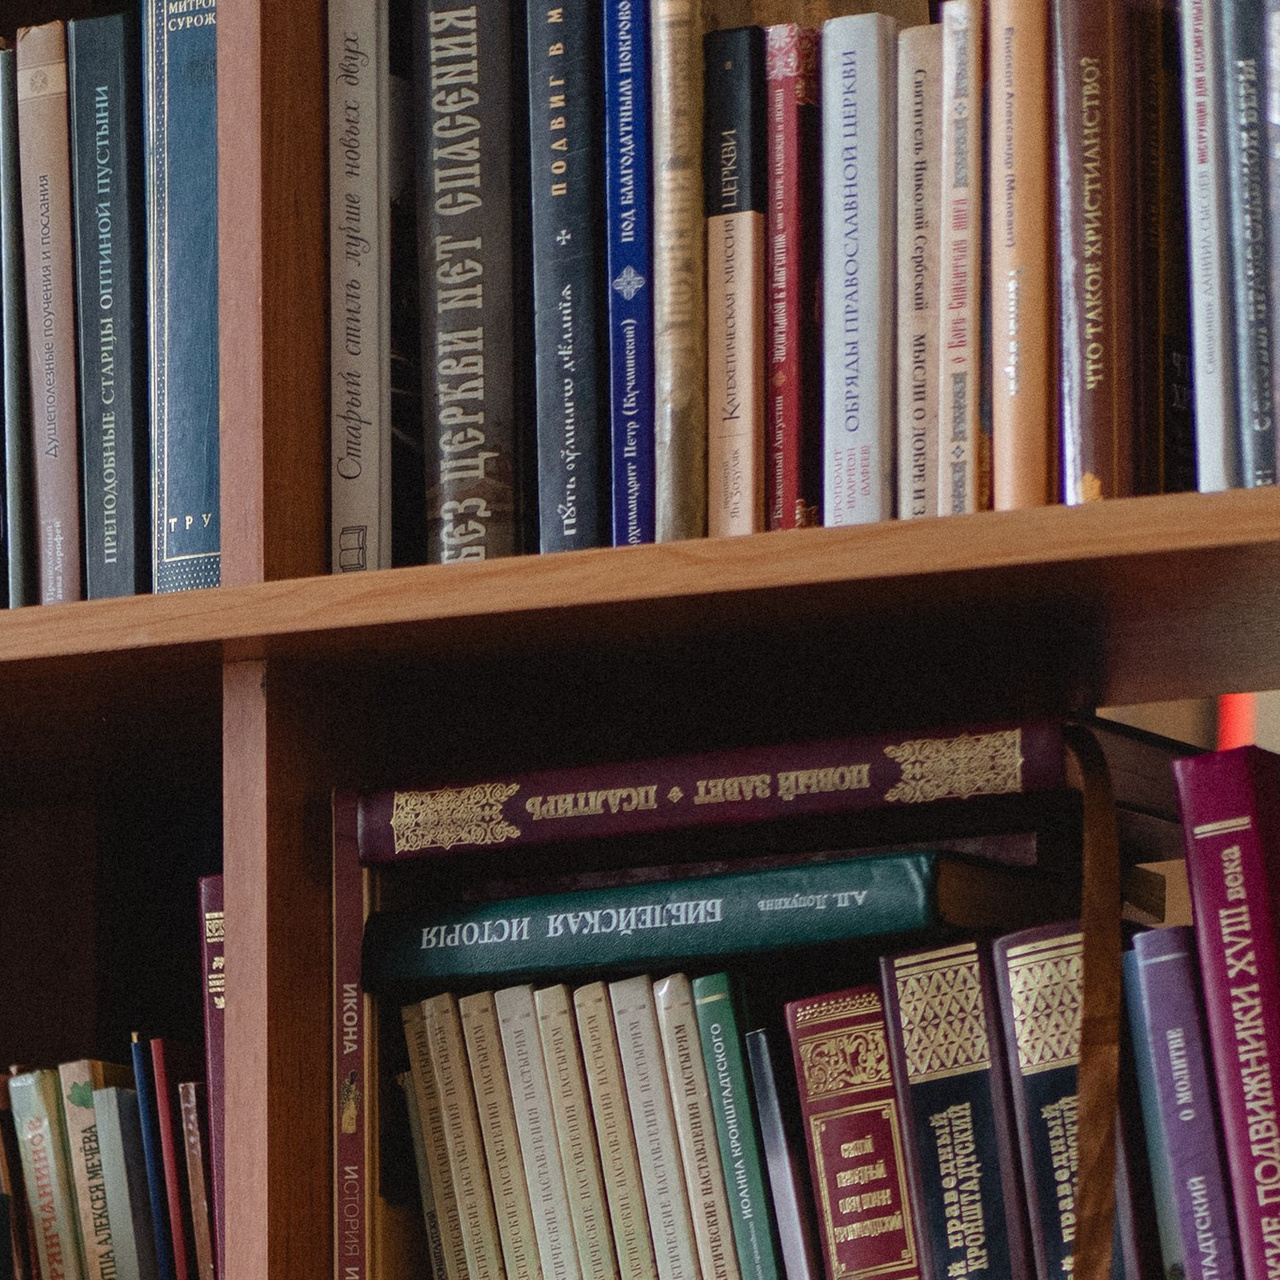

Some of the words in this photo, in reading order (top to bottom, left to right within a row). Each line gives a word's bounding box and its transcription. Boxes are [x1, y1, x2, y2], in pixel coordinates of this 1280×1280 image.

[334, 30, 368, 88] двух
[841, 50, 858, 140] ЦЕРКВИ
[94, 84, 112, 194] ПУСТЫНИ
[340, 101, 363, 179] новых
[429, 5, 483, 216] СПАСЕНИЯ
[546, 74, 569, 196] ПОДВИГ
[617, 79, 636, 205] БЛАГОДАТНЫМ
[719, 129, 739, 209] ЦЕРКВИ
[913, 159, 930, 231] Николай
[1081, 56, 1102, 257] ХРИСТИАНСТВО?
[36, 175, 54, 247] послания
[338, 194, 371, 267] лучше
[840, 145, 860, 334] ПРАВОСЛАВНОЙ
[94, 202, 115, 310] ОПТИНОЙ
[436, 235, 484, 315] НЕТ
[722, 218, 737, 285] МИССИЯ
[910, 236, 929, 312] Сербский
[38, 265, 57, 339] поучения
[342, 277, 363, 358] стиль
[1084, 259, 1103, 339] ТАКОЕ
[41, 342, 60, 458] Душеполезные
[98, 317, 118, 405] СТАРЦЫ
[842, 340, 861, 433] ОБРЯДЫ
[1085, 344, 1104, 390] ЧТО
[336, 370, 370, 480] Старый
[435, 328, 487, 484] ЦЕРКВИ
[101, 411, 119, 564] ПРЕПОДОБНЫЕ
[524, 784, 658, 823] ПСАЛТИРЬ
[693, 772, 772, 806] ЗАВЕТ
[778, 762, 872, 801] НОВЫЙ
[1219, 846, 1247, 900] века
[420, 916, 532, 951] ИСТОРІЯ
[546, 896, 724, 939] БИБЛЕЙСКАЯ
[1217, 905, 1256, 976] XVIII
[340, 983, 360, 1056] ИКОНА
[672, 1022, 699, 1098] ПАСТЫРЯМ
[708, 1022, 744, 1157] КРОНШТАДТСКОГО
[1164, 1027, 1194, 1104] МОЛИТВЕ
[1228, 984, 1277, 1208] ПОДВИЖНИКИ
[79, 1123, 105, 1182] МЕЧЁВА
[686, 1101, 716, 1197] НАСТАВЛЕНИЯ
[927, 1110, 965, 1249] праведный
[946, 1101, 990, 1271] КРОНШТАДТСКИЙ
[89, 1182, 115, 1247] АЛЕКСЕЯ
[342, 1165, 361, 1258] ИСТОРИЯ
[732, 1159, 755, 1220] ИОАННА
